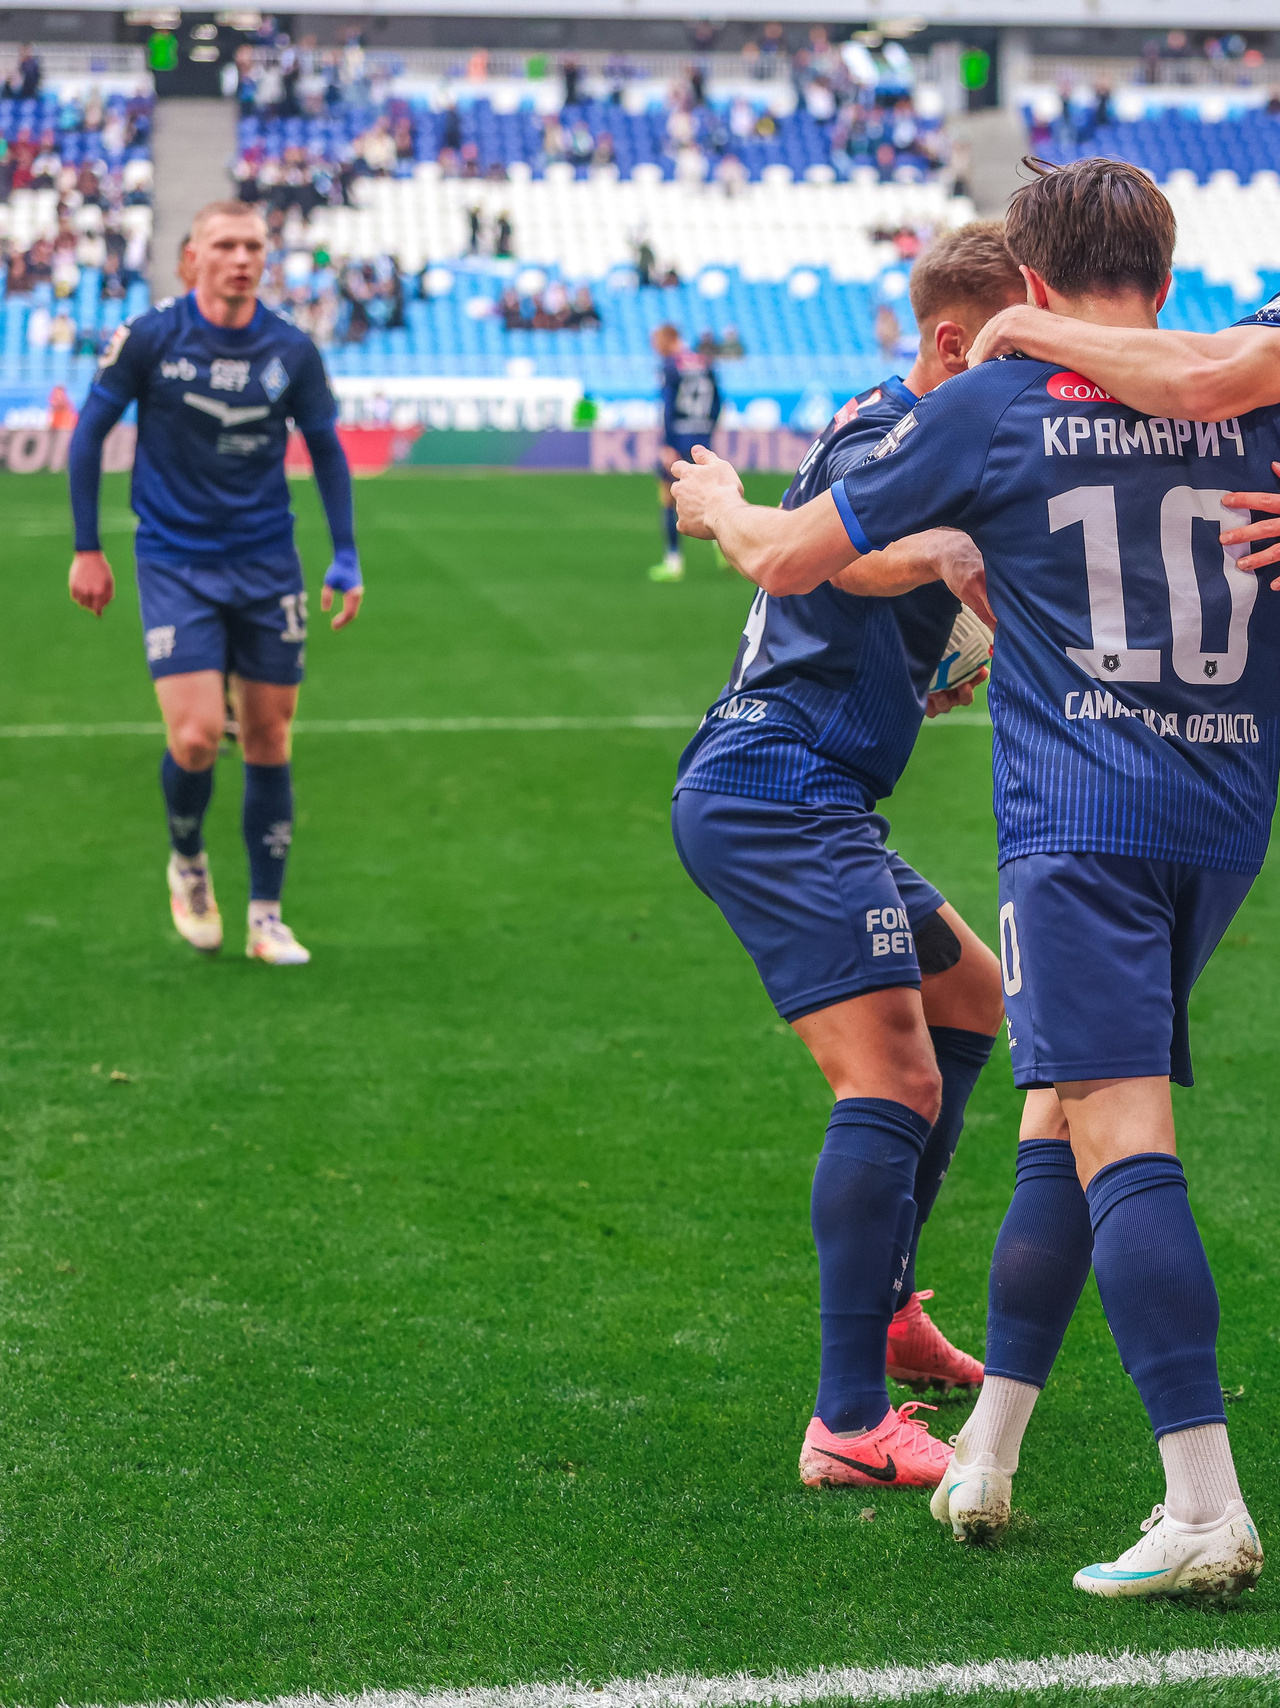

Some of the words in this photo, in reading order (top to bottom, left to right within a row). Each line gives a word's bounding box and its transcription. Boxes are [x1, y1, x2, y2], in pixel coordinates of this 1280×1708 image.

[1042, 416, 1246, 457] КРАМАРИЧ
[1048, 485, 1259, 685] 10
[1186, 713, 1260, 744] ОБЛАСТЬ
[866, 907, 911, 932] FON
[872, 932, 914, 957] BET
